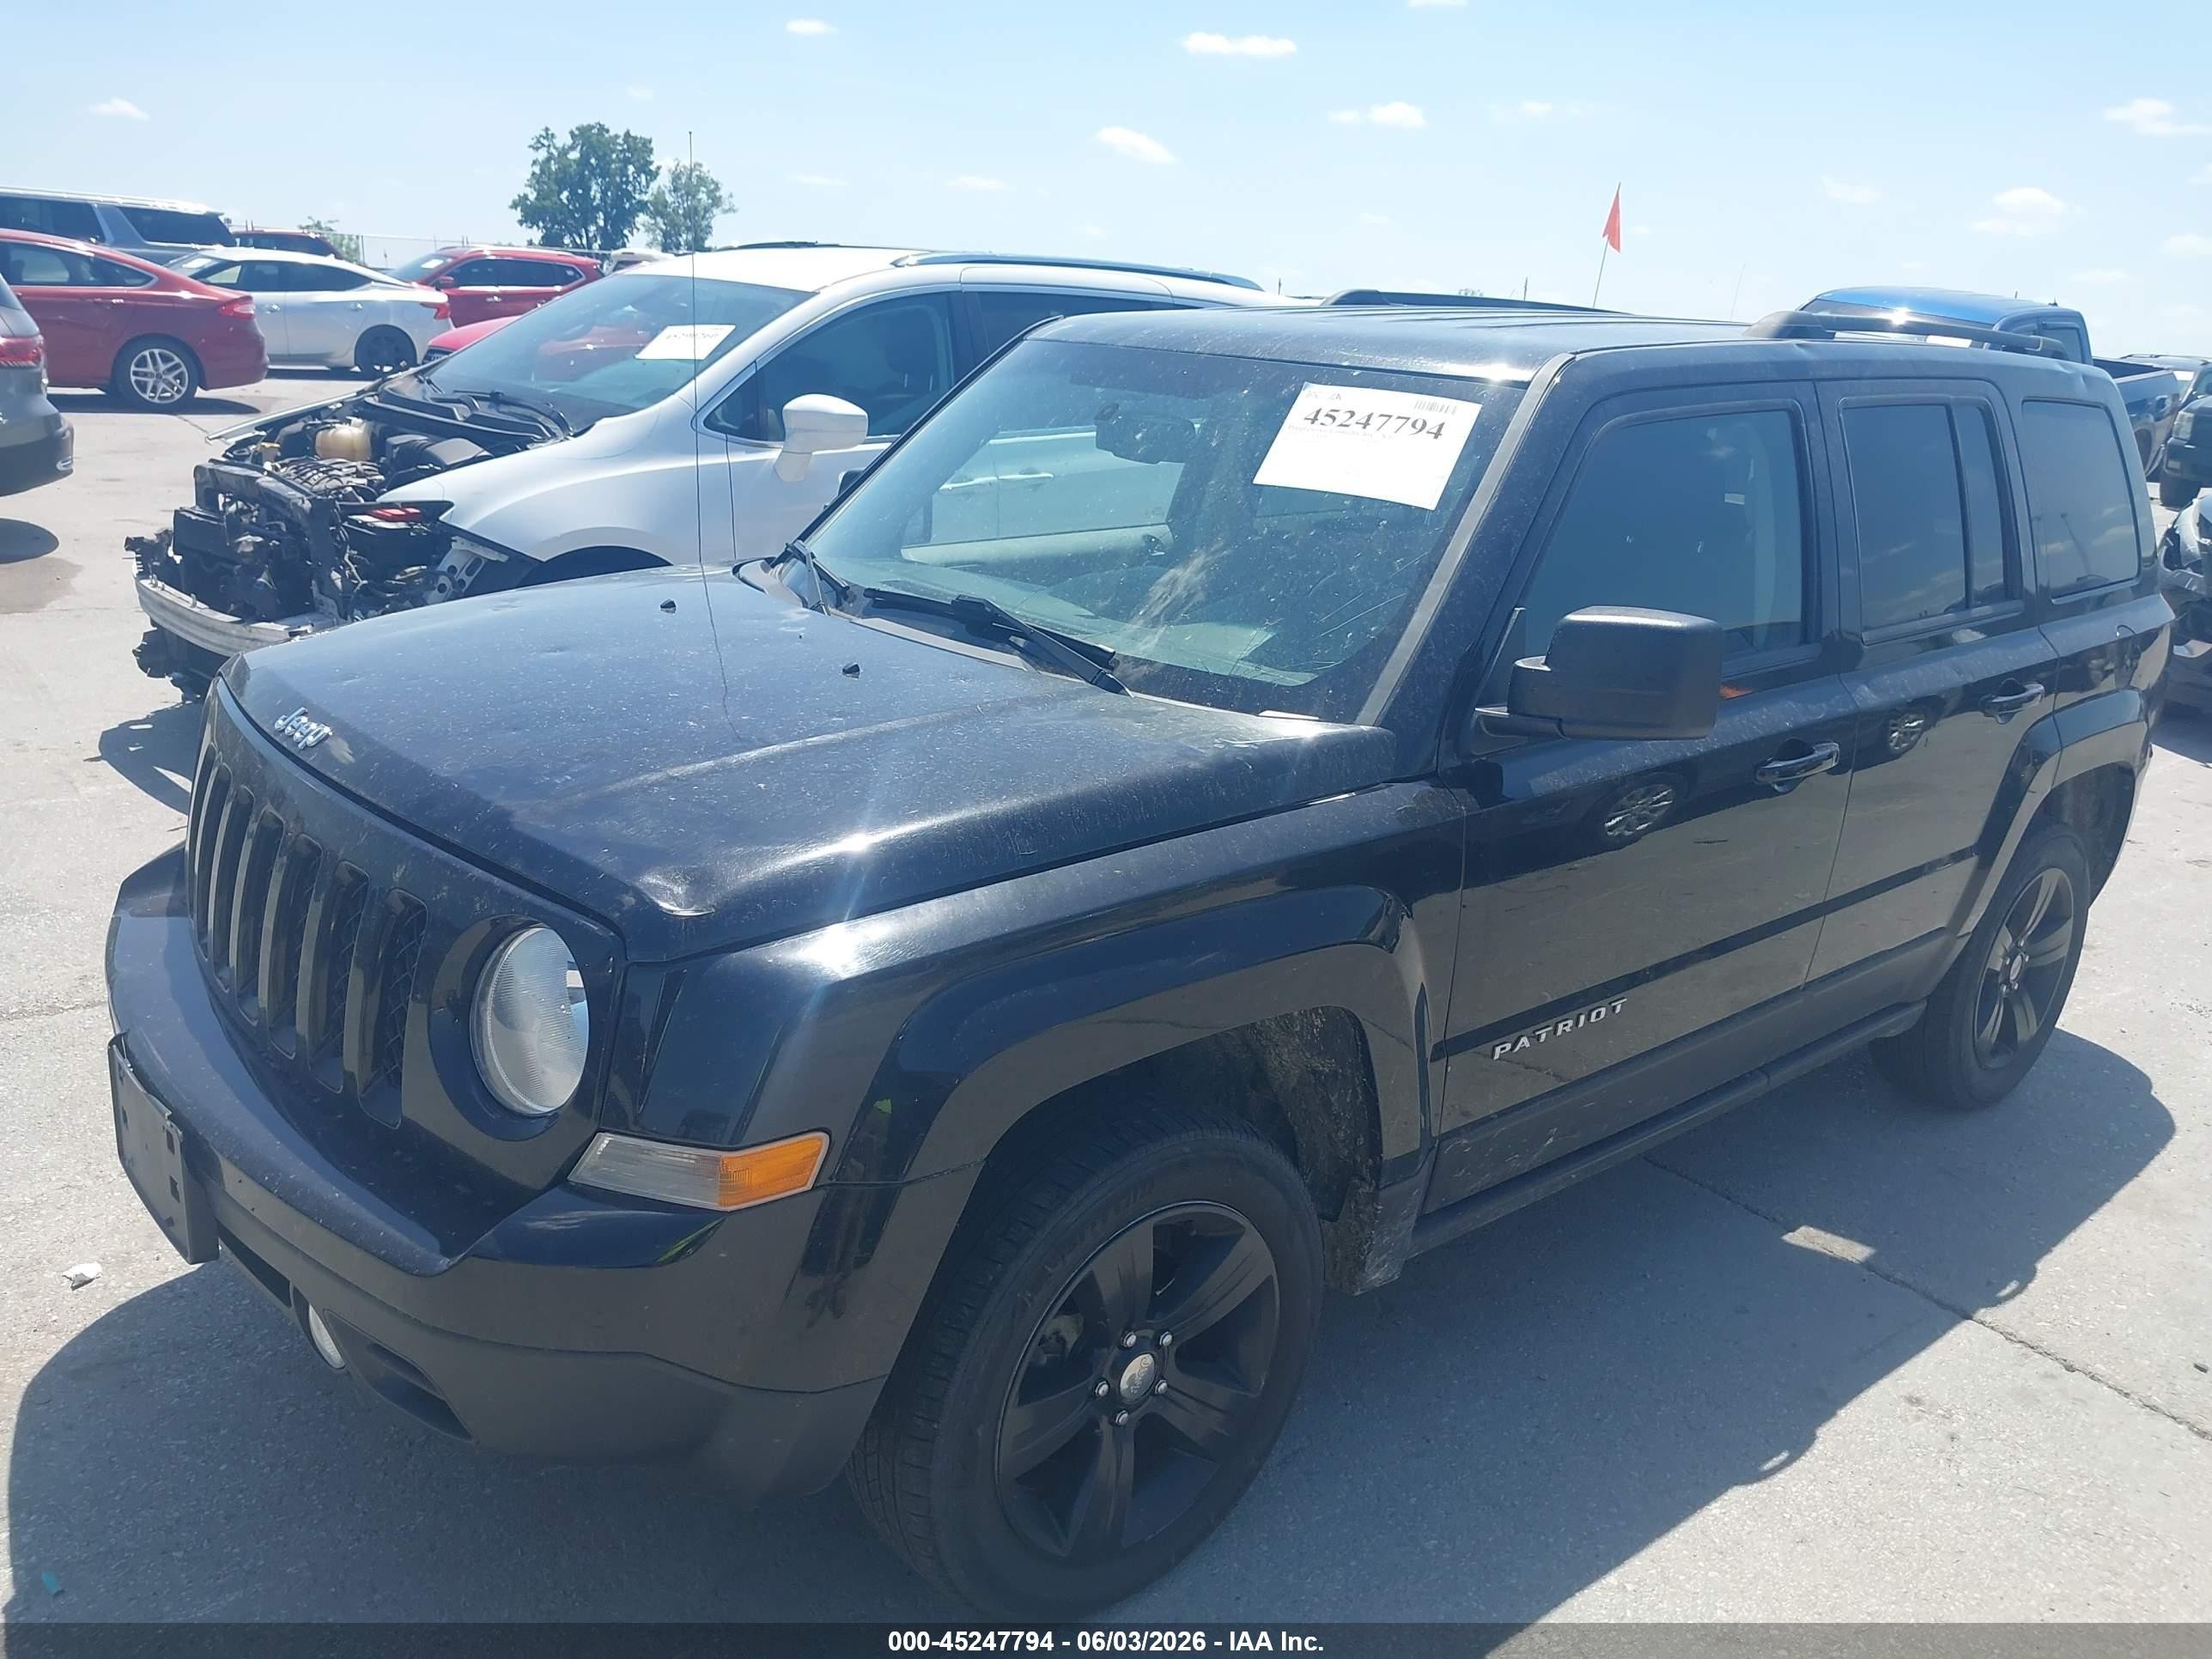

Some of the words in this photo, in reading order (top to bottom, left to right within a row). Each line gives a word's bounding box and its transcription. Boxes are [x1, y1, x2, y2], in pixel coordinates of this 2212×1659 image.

[1303, 407, 1446, 441] 45247794
[274, 707, 332, 750] Jeep
[1492, 997, 1627, 1060] PATRIOT
